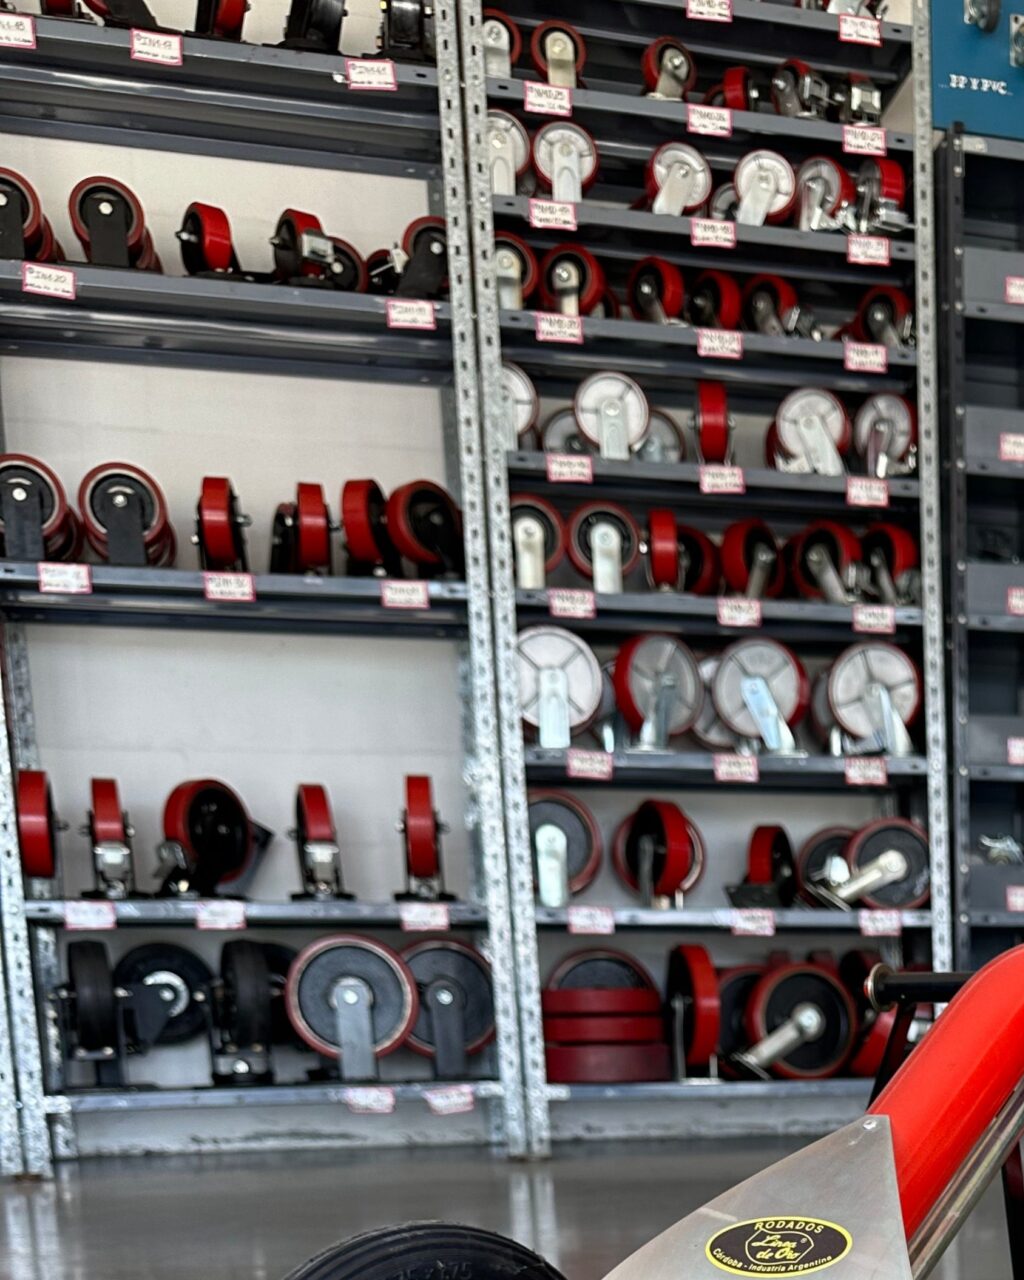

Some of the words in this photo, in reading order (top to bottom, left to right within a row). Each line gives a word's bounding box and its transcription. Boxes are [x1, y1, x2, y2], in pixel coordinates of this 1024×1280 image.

[754, 1219, 825, 1235] RODADOS
[748, 1263, 786, 1273] Industria
[788, 1254, 833, 1272] Argentina
